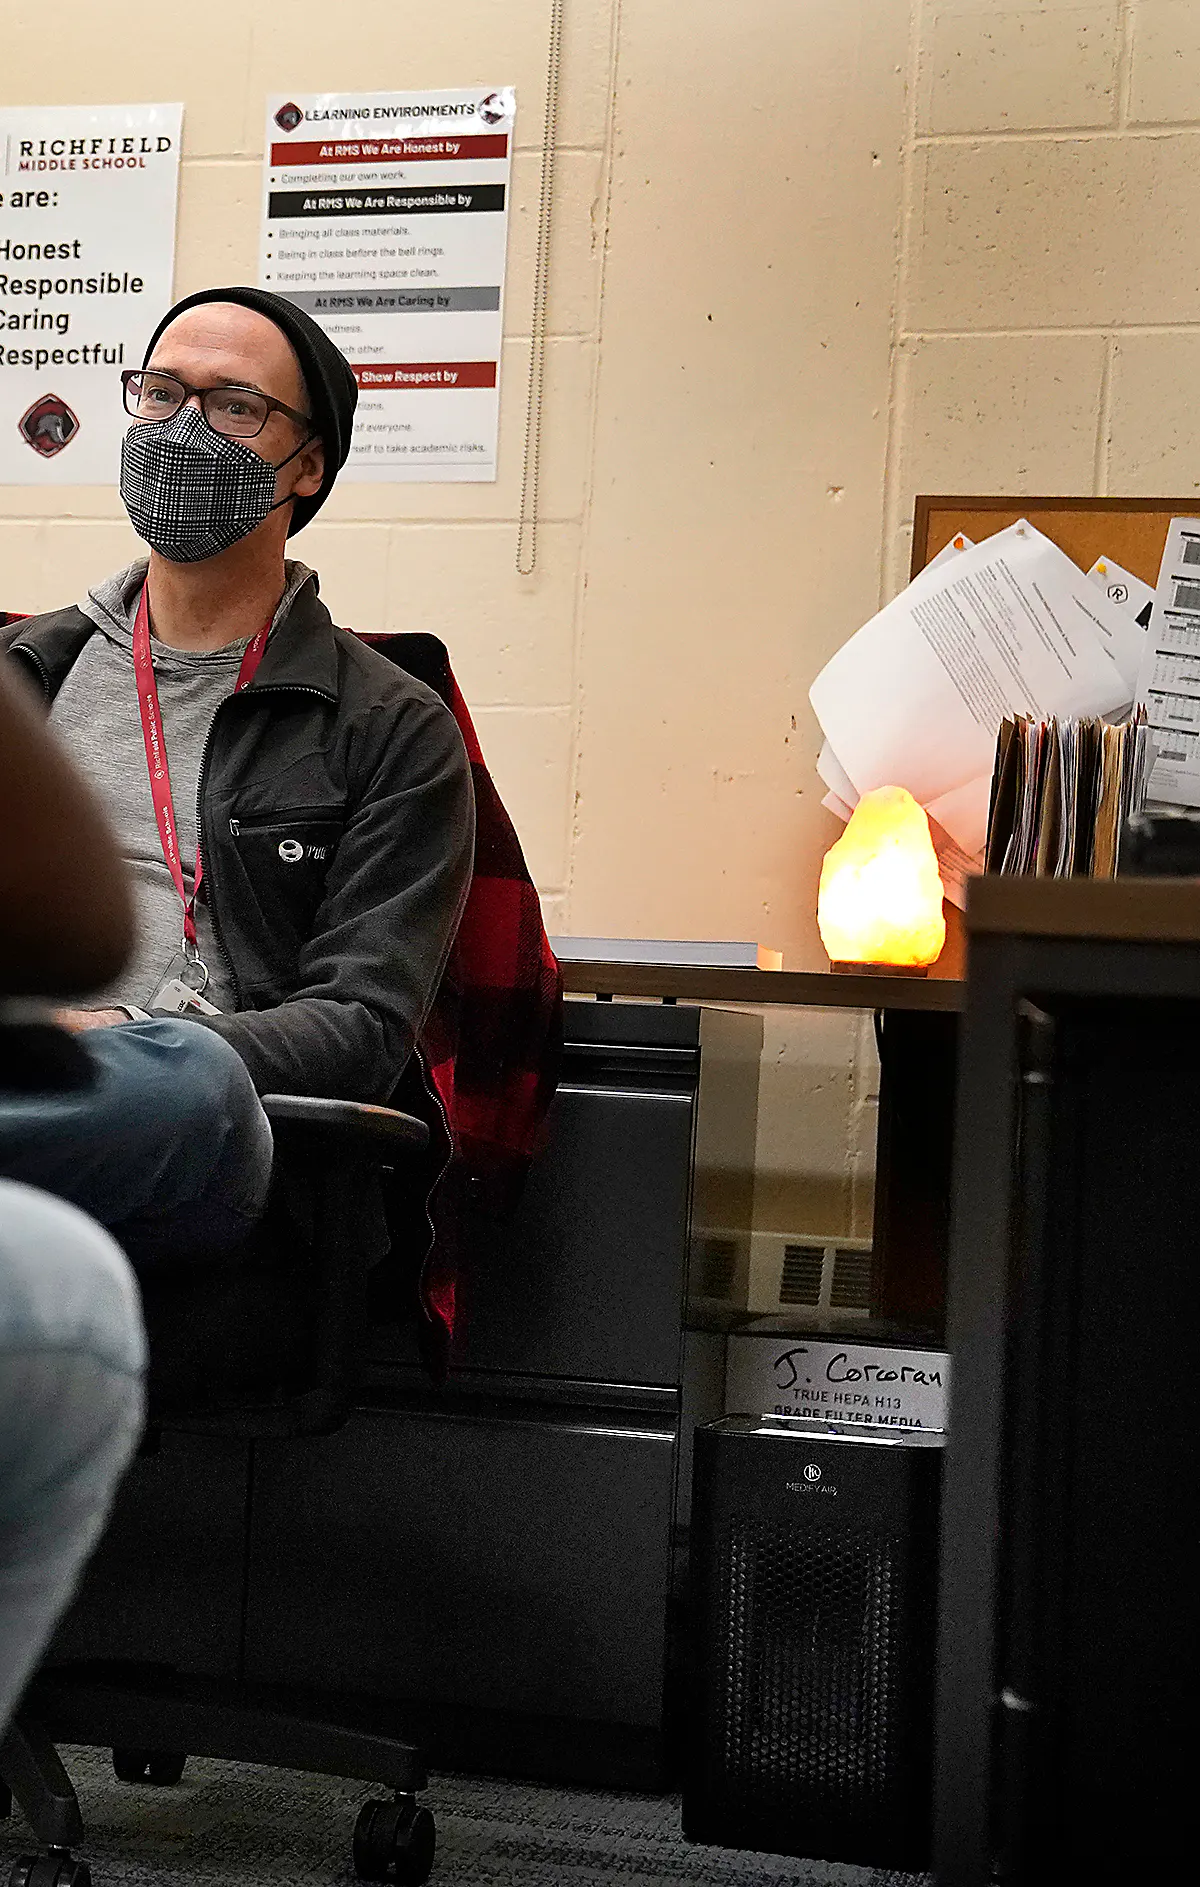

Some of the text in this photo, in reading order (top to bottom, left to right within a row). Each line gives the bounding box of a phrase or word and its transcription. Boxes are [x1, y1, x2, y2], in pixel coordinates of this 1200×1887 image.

[305, 103, 475, 121] LEARNING ENVIRONMENTS
[20, 136, 172, 157] RICHFIELD
[319, 140, 461, 157] At RMS We Are Honest by
[18, 156, 146, 172] MIDDLE SCHOOL
[281, 172, 338, 184] Completing
[380, 170, 406, 180] work.
[10, 190, 59, 208] are:
[302, 192, 473, 210] At RMS We Are Responsible by
[278, 226, 411, 240] Bringing all class materials.
[277, 250, 306, 261] Being
[318, 249, 344, 259] class
[345, 248, 378, 259] before
[379, 247, 396, 258] the
[397, 246, 416, 257] bell
[417, 246, 445, 258] rings.
[276, 267, 440, 281] Keeping the learning space clean.
[314, 294, 449, 308] At RMS We Are Caring by
[325, 323, 363, 334] indness.
[361, 370, 394, 383] Show
[394, 370, 441, 384] Respect
[443, 369, 459, 384] by
[826, 1352, 943, 1388] Corcoran
[793, 1388, 901, 1409] TRUE HEPA H13
[774, 1404, 922, 1428] GRADE FILTER MEDIA
